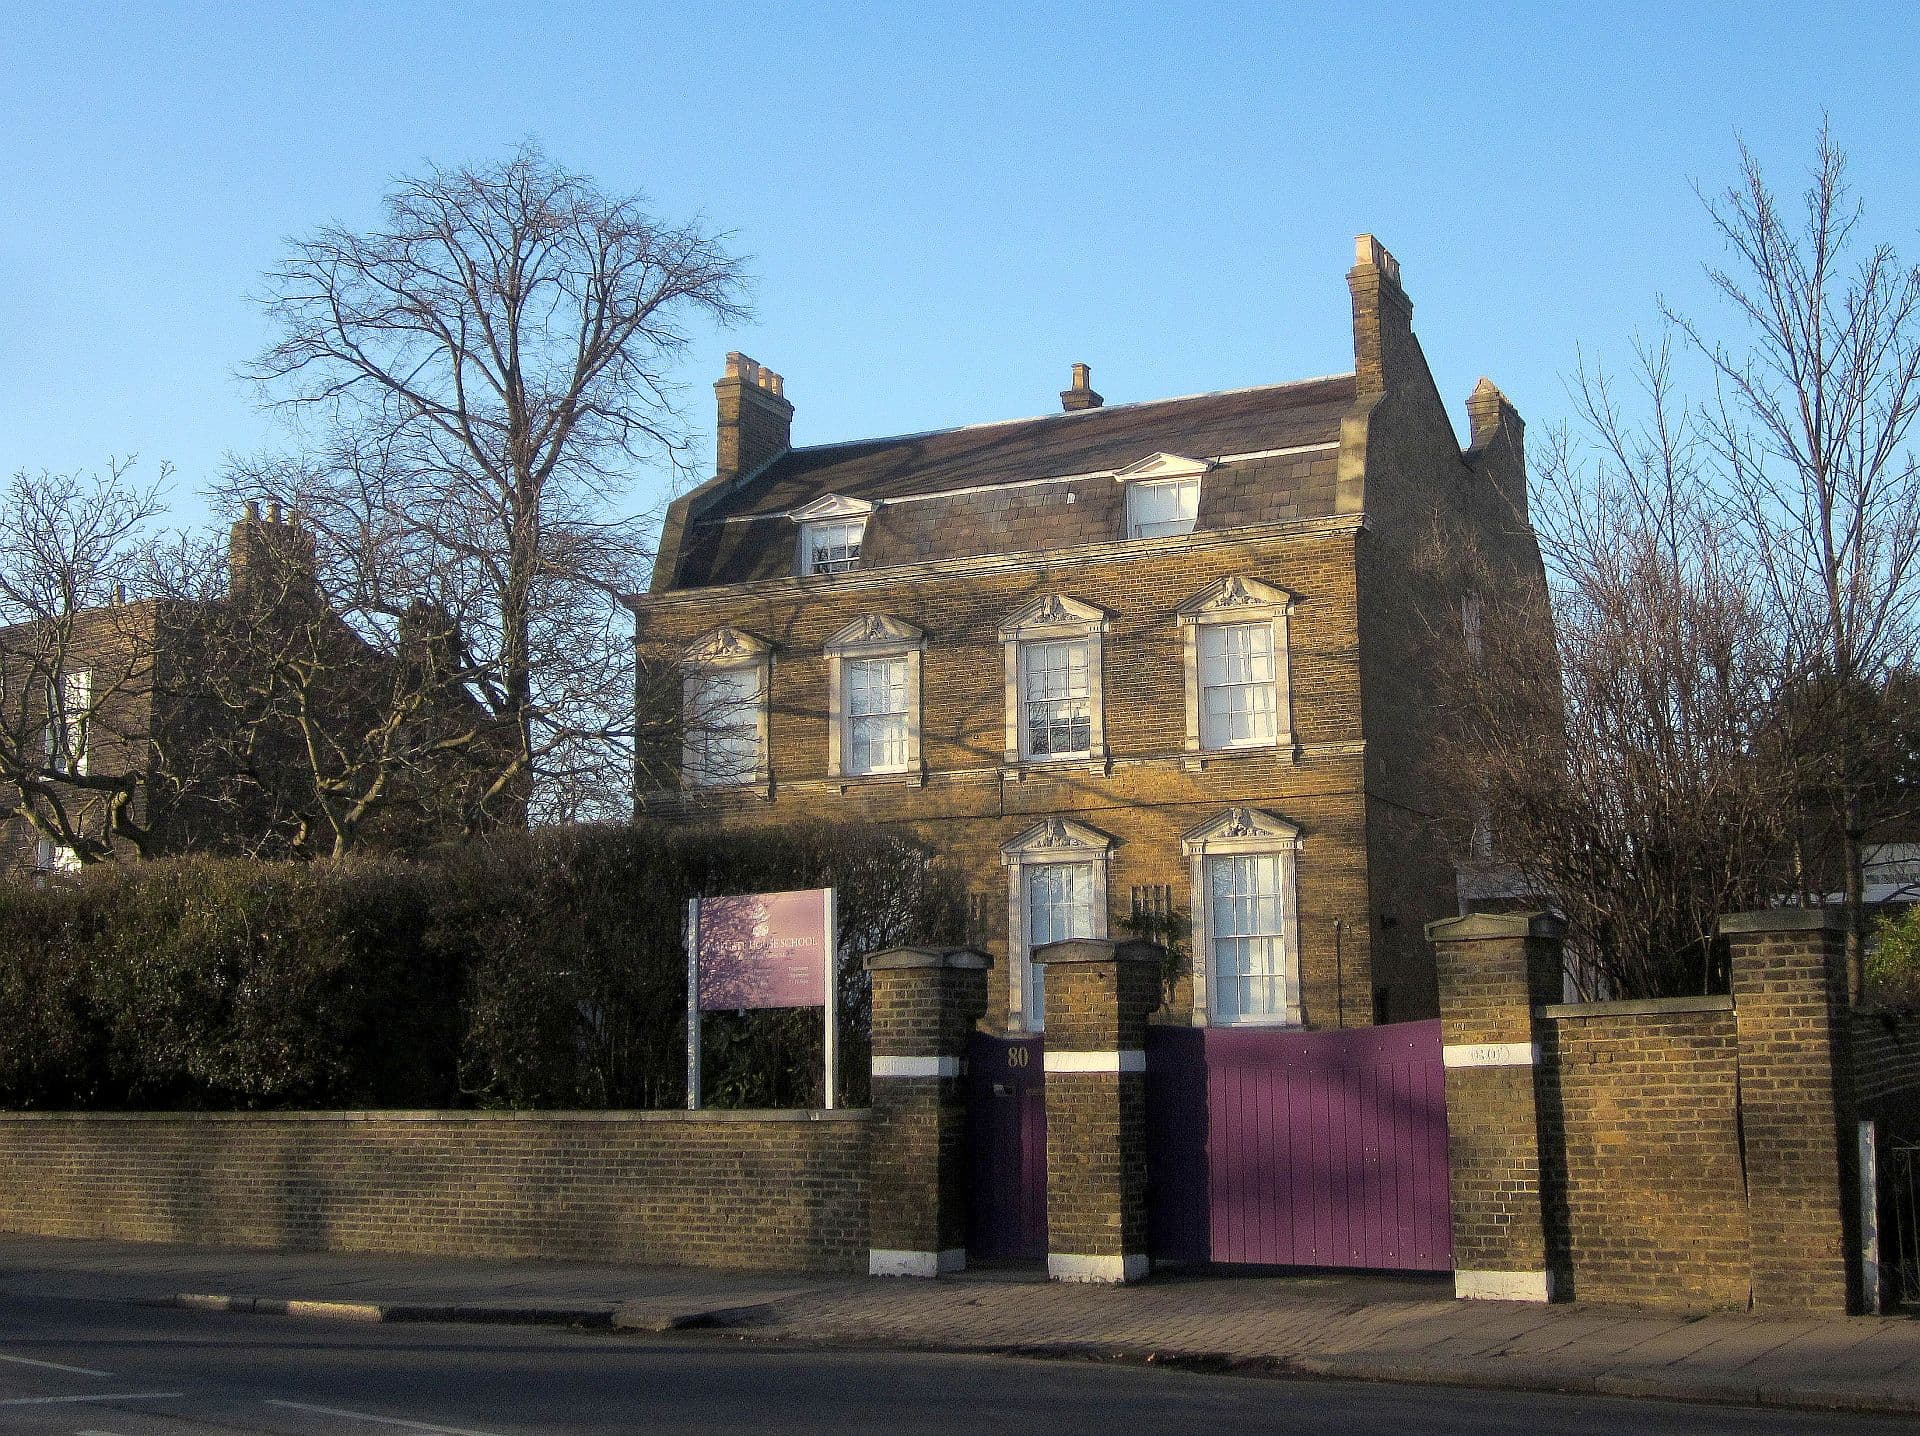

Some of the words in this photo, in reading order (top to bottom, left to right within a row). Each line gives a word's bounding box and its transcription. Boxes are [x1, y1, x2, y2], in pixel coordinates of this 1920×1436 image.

[749, 938, 779, 950] HOUSE
[780, 936, 818, 948] SCHOOL
[1008, 1047, 1028, 1067] 80
